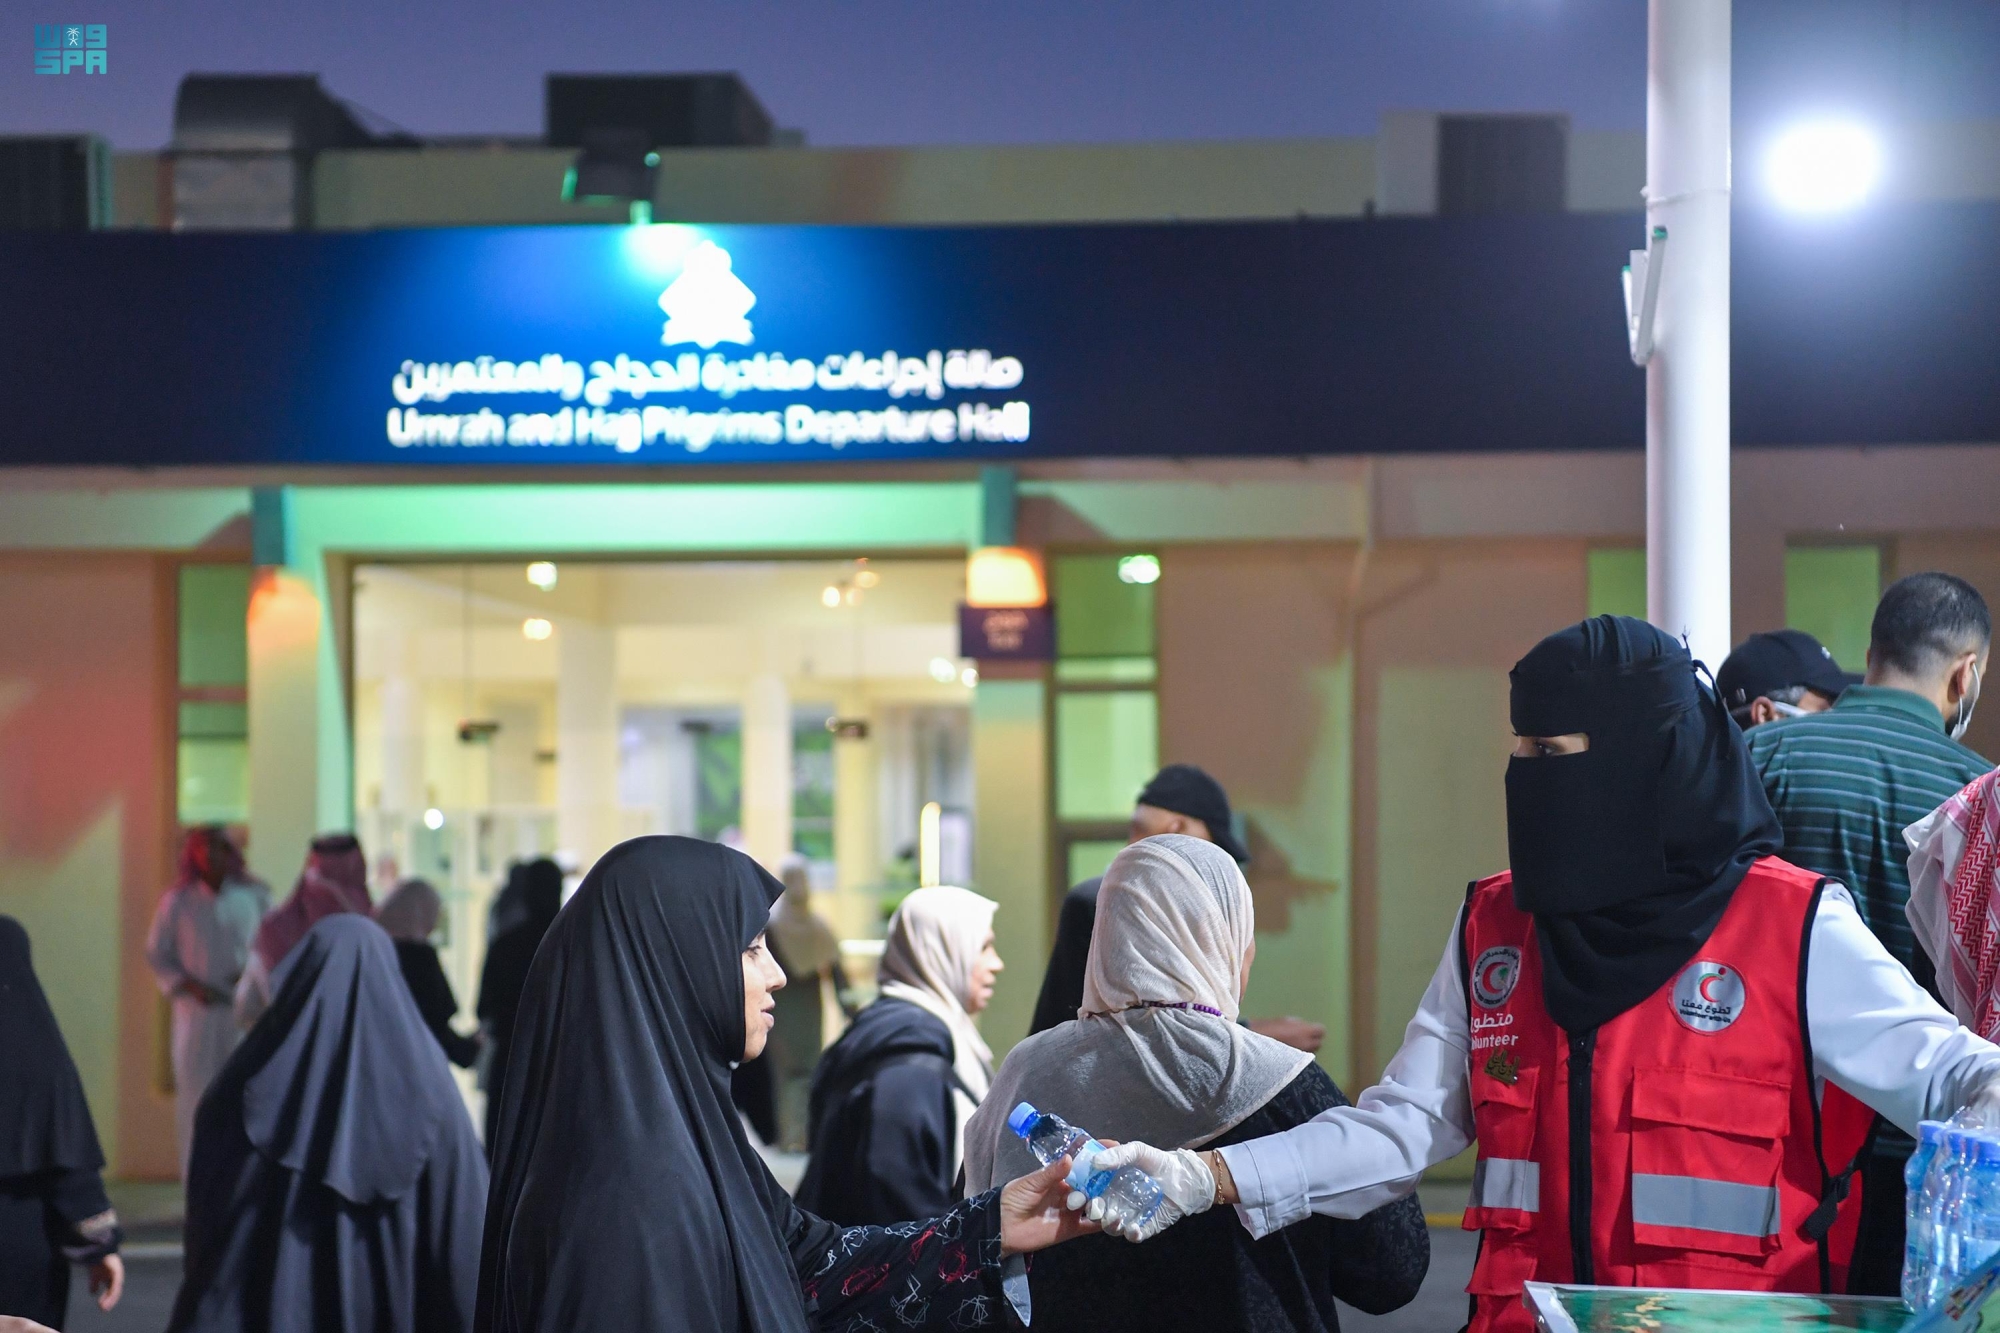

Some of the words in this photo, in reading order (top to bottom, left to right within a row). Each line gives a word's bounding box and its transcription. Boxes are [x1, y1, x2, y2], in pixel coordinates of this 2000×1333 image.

[392, 353, 584, 404] والمعتمرين
[584, 353, 700, 406] الحجاج
[701, 351, 816, 398] مغادرة
[816, 349, 943, 399] إجراءات
[944, 349, 1024, 389] صالة
[387, 407, 506, 448] Umrah
[506, 406, 574, 446] and
[643, 405, 783, 453] Pilgrims
[785, 404, 957, 450] Departure
[957, 401, 1030, 442] Hall
[1472, 1034, 1519, 1051] olunteer
